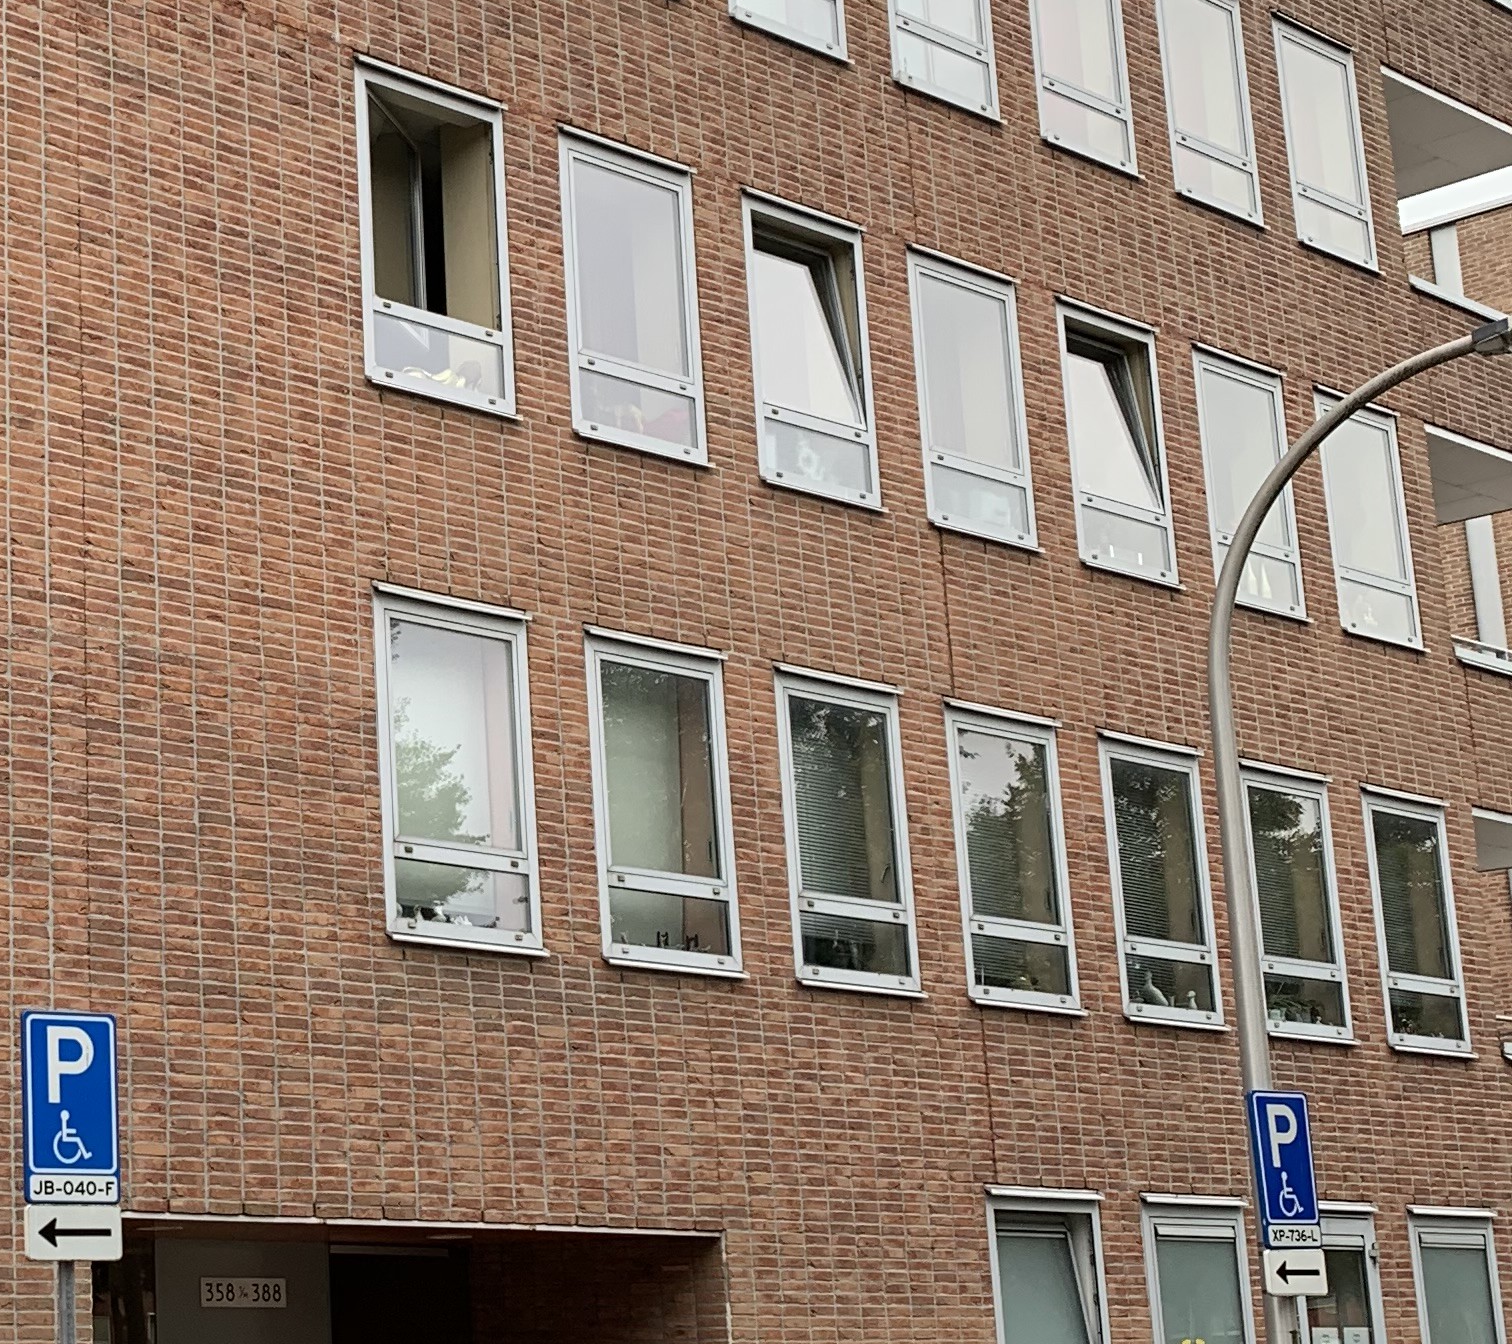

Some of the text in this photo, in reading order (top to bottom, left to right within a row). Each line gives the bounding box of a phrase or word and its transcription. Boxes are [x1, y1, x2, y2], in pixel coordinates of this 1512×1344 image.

[46, 1024, 95, 1104] P
[1265, 1103, 1298, 1168] P
[33, 1180, 115, 1197] JB-040-F
[1271, 1229, 1319, 1243] XP-736-L
[205, 1282, 235, 1302] 358
[252, 1283, 282, 1303] 388
